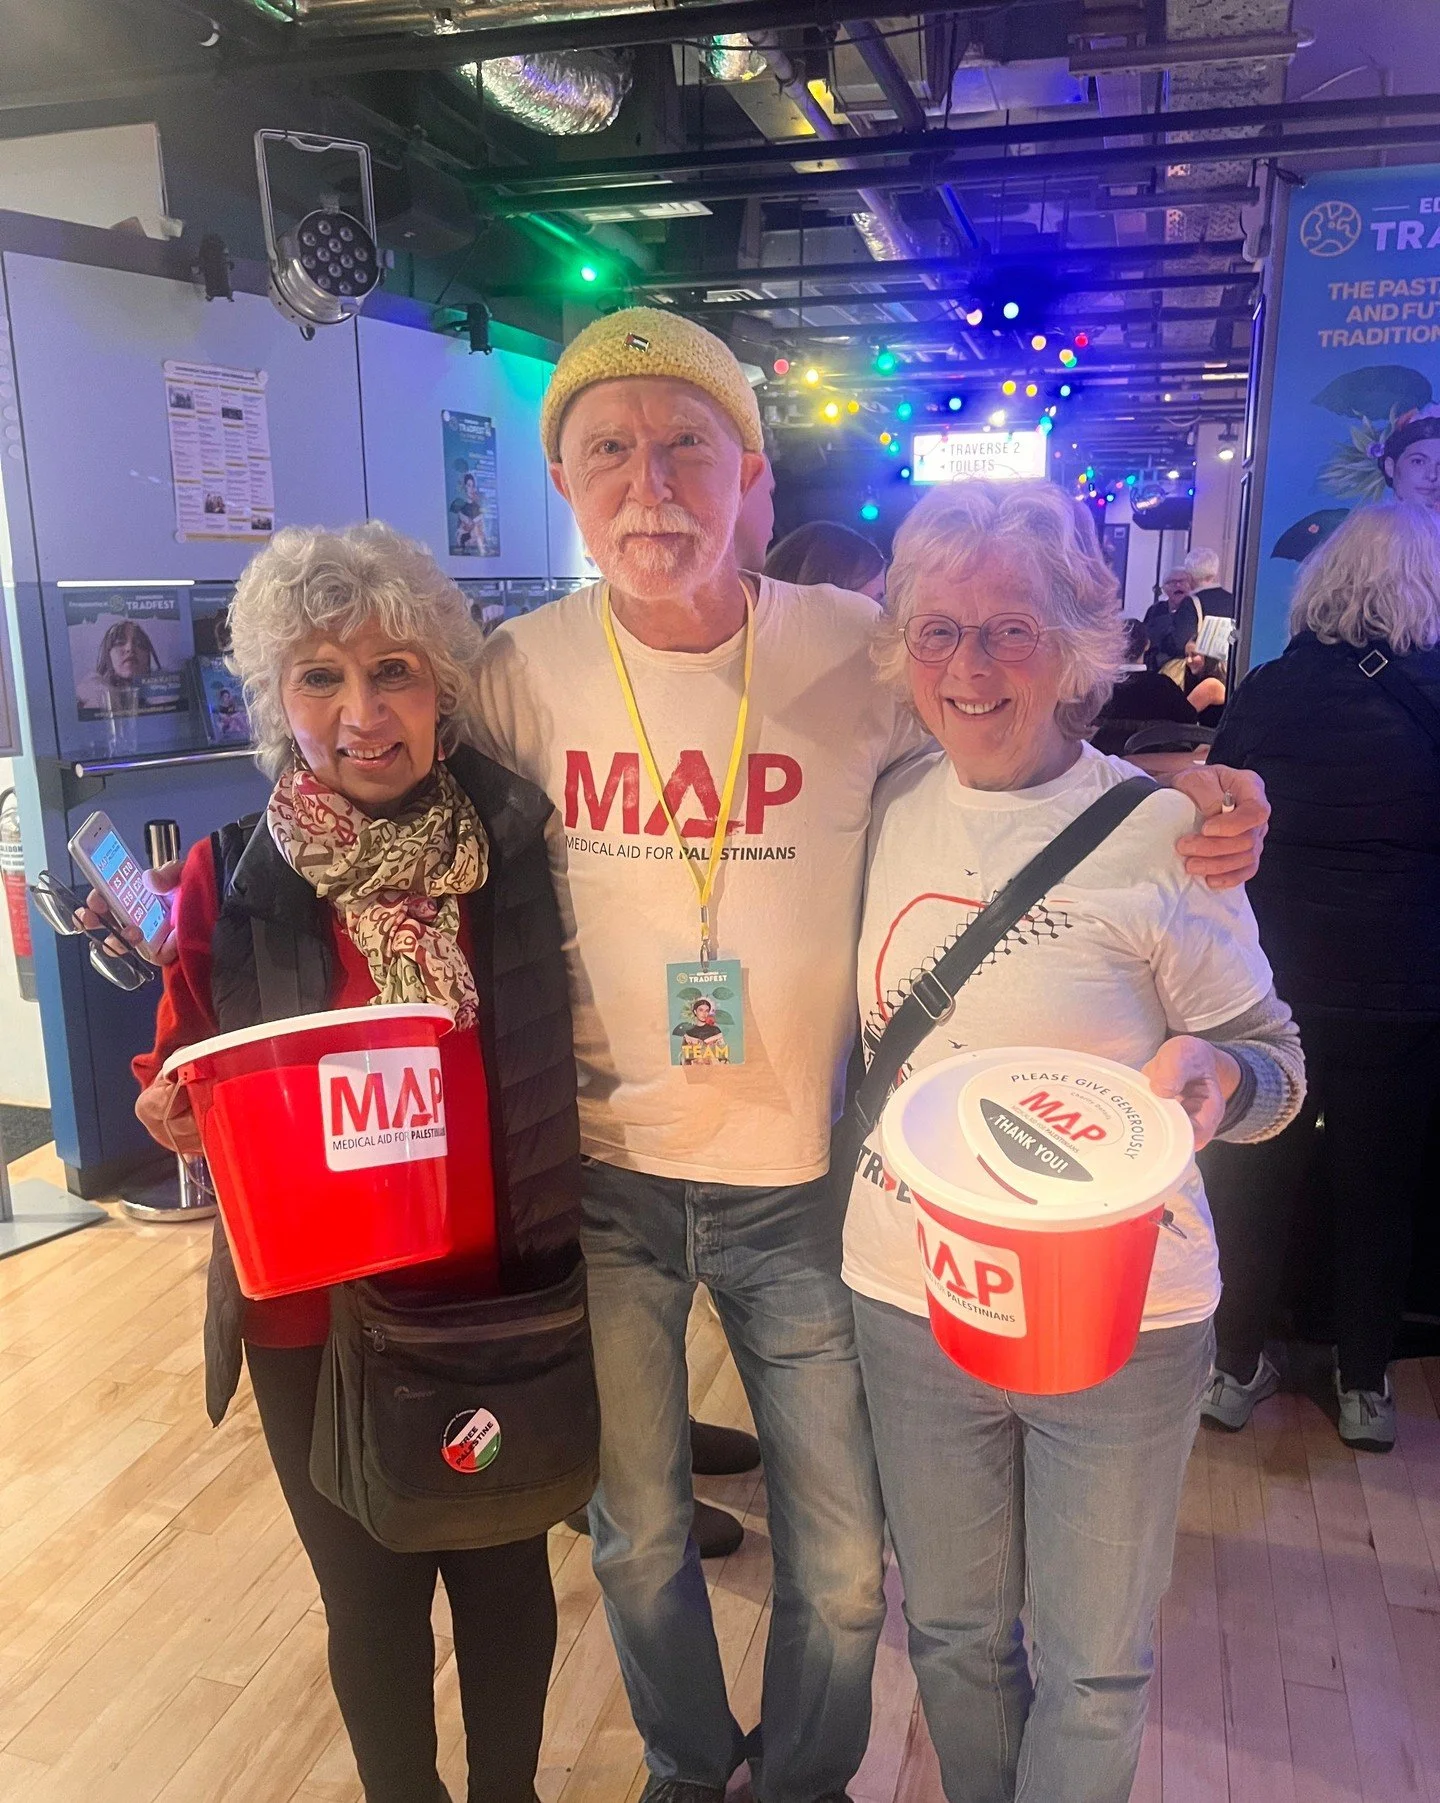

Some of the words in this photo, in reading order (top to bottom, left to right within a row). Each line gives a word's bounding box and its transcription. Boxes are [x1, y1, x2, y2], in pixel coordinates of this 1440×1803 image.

[1328, 280, 1375, 300] THE
[1346, 303, 1399, 323] AND
[950, 442, 1009, 455] TRAVERSE
[1014, 442, 1021, 454] 2
[950, 459, 995, 473] TOILETS
[125, 600, 175, 611] TRADFEST
[565, 750, 803, 838] MAP
[565, 835, 614, 856] MEDICAL
[617, 845, 641, 859] AID
[646, 847, 674, 860] FOR
[679, 846, 796, 861] PALSTINIANS
[113, 877, 122, 890] £5
[122, 861, 133, 877] £10
[689, 975, 728, 984] TRADFEST
[682, 1044, 729, 1059] TEAM
[330, 1067, 443, 1136] MAP
[1011, 1072, 1069, 1083] PLEASE
[1075, 1078, 1111, 1096] GIVE
[1110, 1095, 1145, 1160] GENEROUSLY
[1019, 1091, 1107, 1141] MAP
[332, 1136, 375, 1151] MEDICAL
[377, 1133, 392, 1145] AID
[994, 1114, 1037, 1150] THANK
[1034, 1143, 1069, 1174] YOU!
[947, 1290, 1016, 1322] PALESTINIANS
[456, 1421, 494, 1465] PALESTINE
[459, 1425, 478, 1448] FREE
